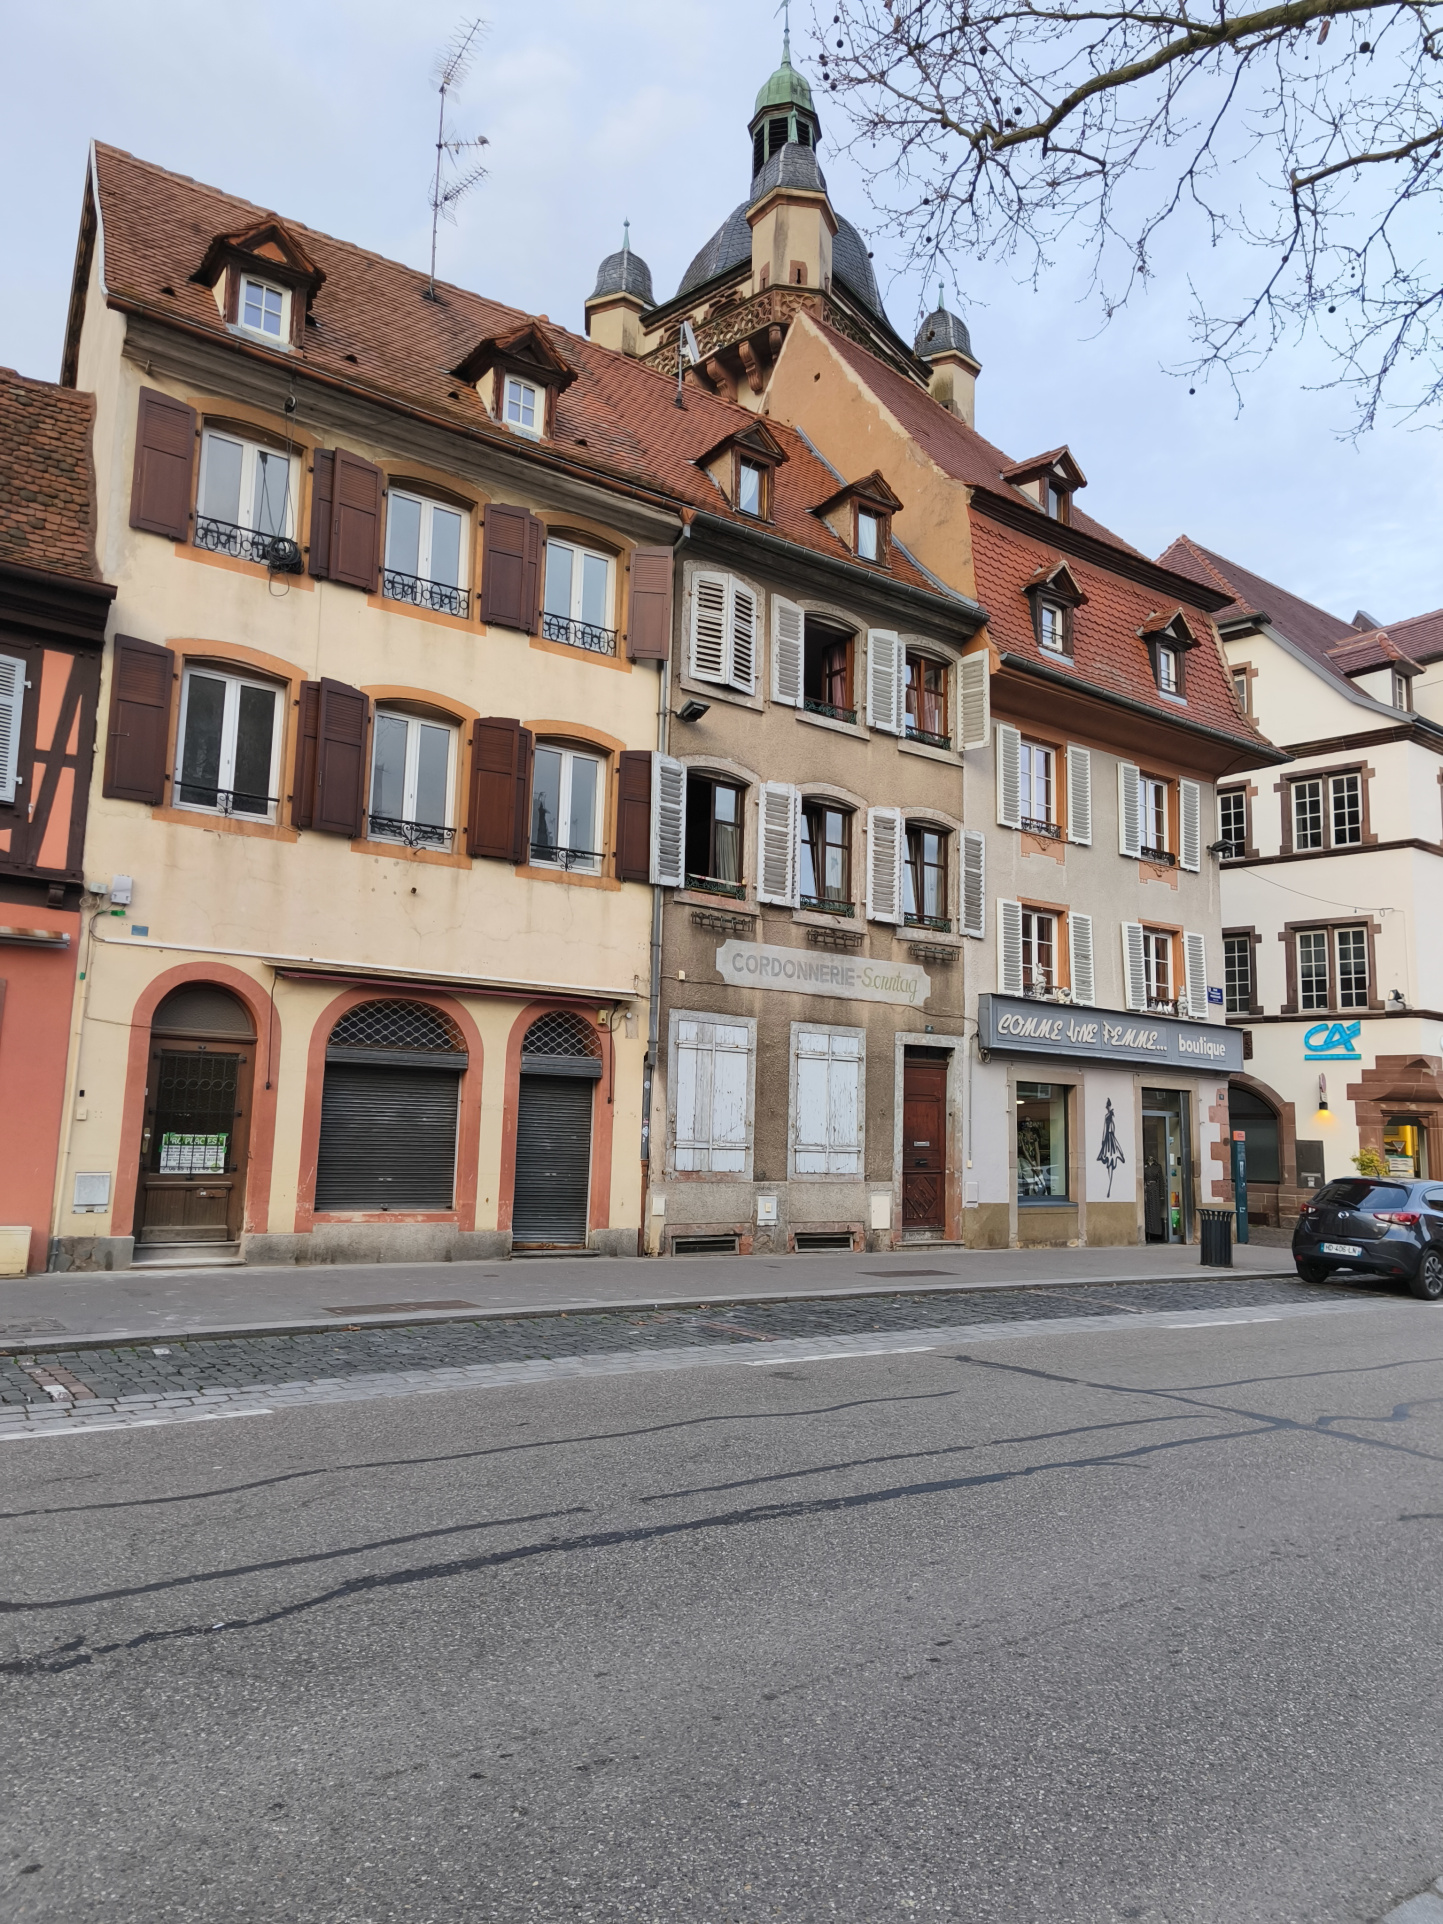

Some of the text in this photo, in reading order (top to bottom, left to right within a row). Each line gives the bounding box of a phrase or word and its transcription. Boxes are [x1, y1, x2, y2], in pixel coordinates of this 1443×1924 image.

[998, 1013, 1063, 1041] COMME
[1066, 1018, 1098, 1043] UNE
[1179, 1033, 1226, 1060] boutique
[1304, 1020, 1361, 1052] CA
